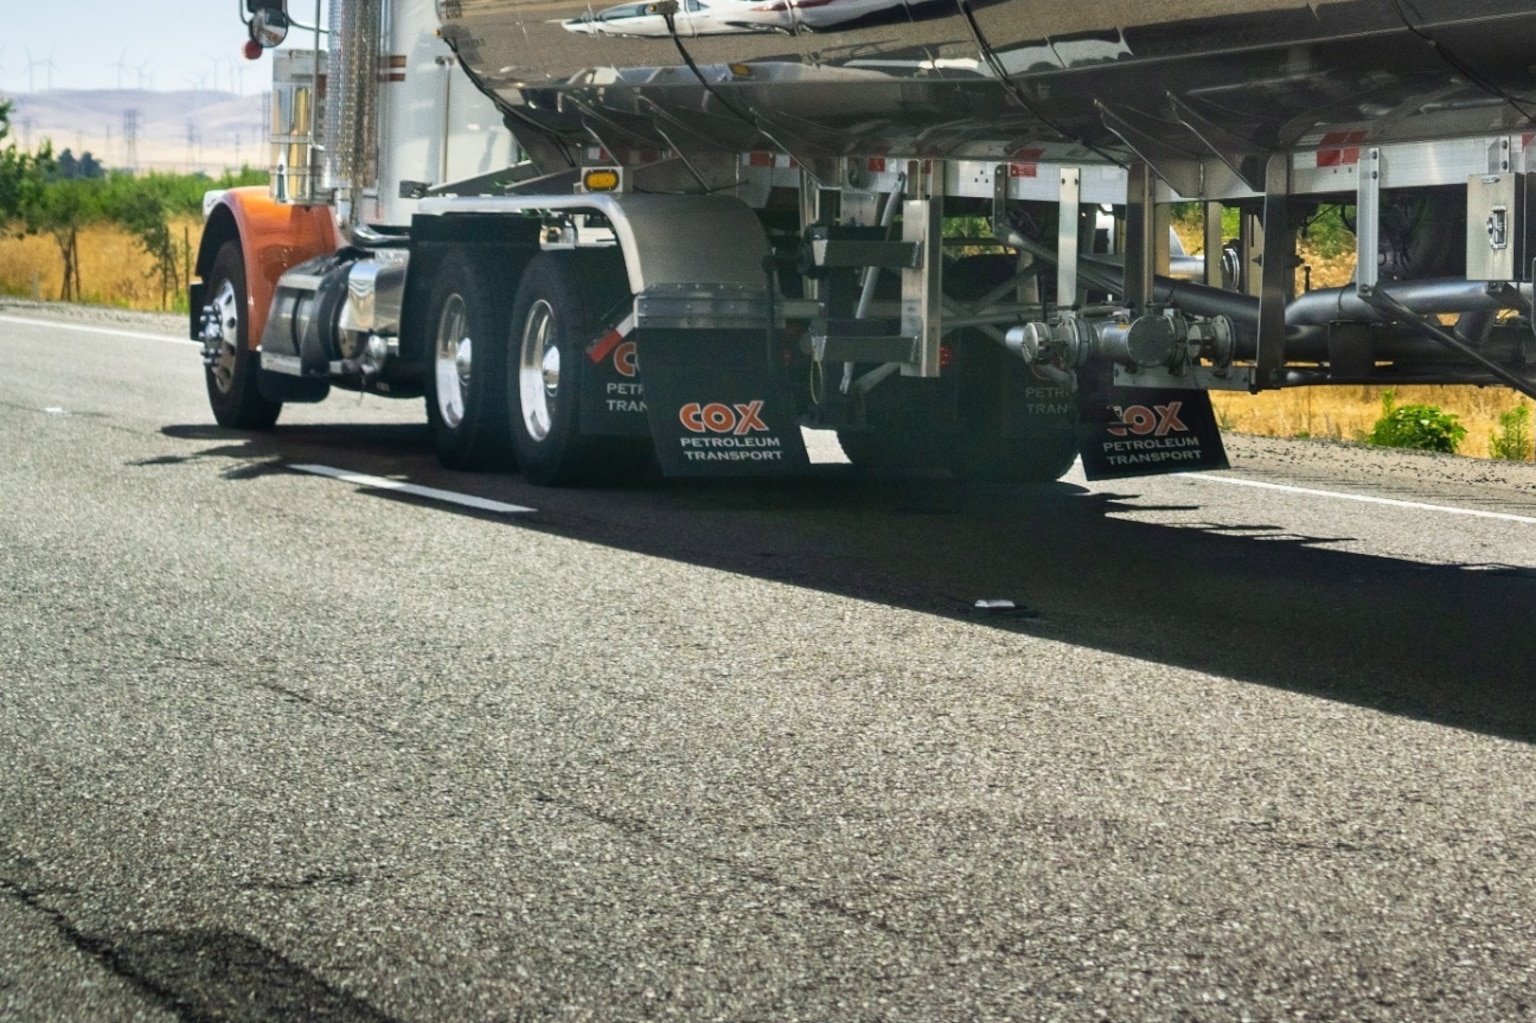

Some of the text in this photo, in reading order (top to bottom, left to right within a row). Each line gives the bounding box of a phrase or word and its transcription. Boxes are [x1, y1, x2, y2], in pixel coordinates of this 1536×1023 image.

[679, 400, 770, 435] COX
[680, 437, 781, 447] PETROLEUM
[1103, 436, 1199, 452] PETROLEUM
[683, 450, 783, 461] TRANSPORT
[1106, 449, 1202, 465] TRANSPORT
